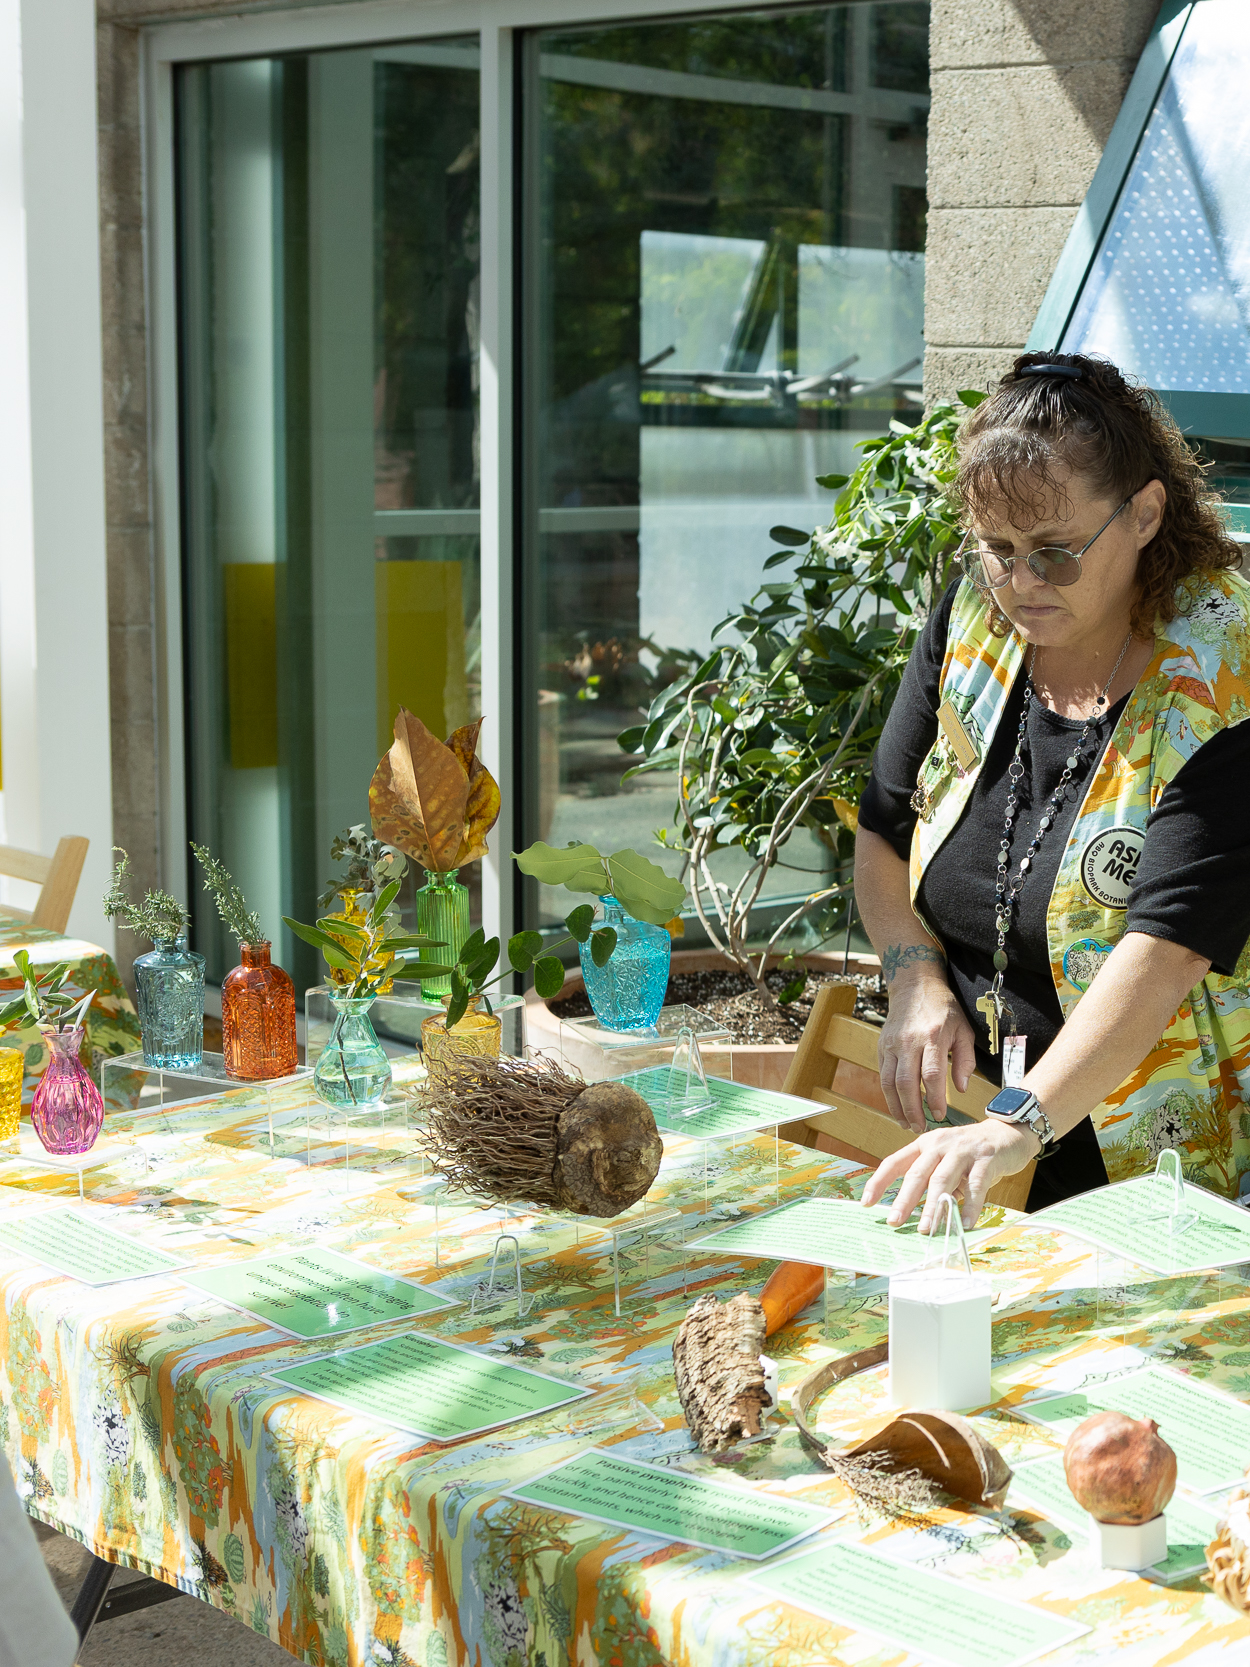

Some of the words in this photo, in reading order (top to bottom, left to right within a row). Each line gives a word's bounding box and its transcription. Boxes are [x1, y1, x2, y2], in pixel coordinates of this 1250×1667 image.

[1092, 842, 1105, 857] ABQ
[1088, 858, 1100, 892] BIOPARK
[1102, 858, 1137, 886] ME
[1098, 891, 1126, 904] BOTANI
[246, 1271, 281, 1287] unique
[248, 1291, 294, 1309] survive!
[266, 1264, 333, 1292] environments
[329, 1290, 359, 1303] often
[355, 1301, 384, 1314] have
[290, 1256, 323, 1269] Plants
[318, 1268, 349, 1281] living
[356, 1284, 414, 1310] challenging
[547, 1473, 590, 1489] quickly,
[592, 1487, 619, 1495] and
[617, 1491, 654, 1505] hence
[655, 1503, 678, 1512] can
[679, 1509, 702, 1518] out
[705, 1515, 759, 1531] compete
[760, 1528, 789, 1538] less
[579, 1468, 600, 1479] fire,
[602, 1476, 672, 1497] particularly
[673, 1494, 707, 1506] when
[719, 1506, 759, 1519] passes
[763, 1517, 790, 1526] over
[595, 1459, 643, 1474] Passive
[638, 1473, 707, 1492] pyrophytes
[710, 1491, 744, 1501] resist
[745, 1499, 766, 1507] the
[768, 1505, 808, 1518] effects
[529, 1482, 582, 1499] resistant
[579, 1497, 619, 1510] plants,
[625, 1507, 661, 1520] which
[662, 1518, 683, 1526] are
[684, 1523, 745, 1542] damaged.
